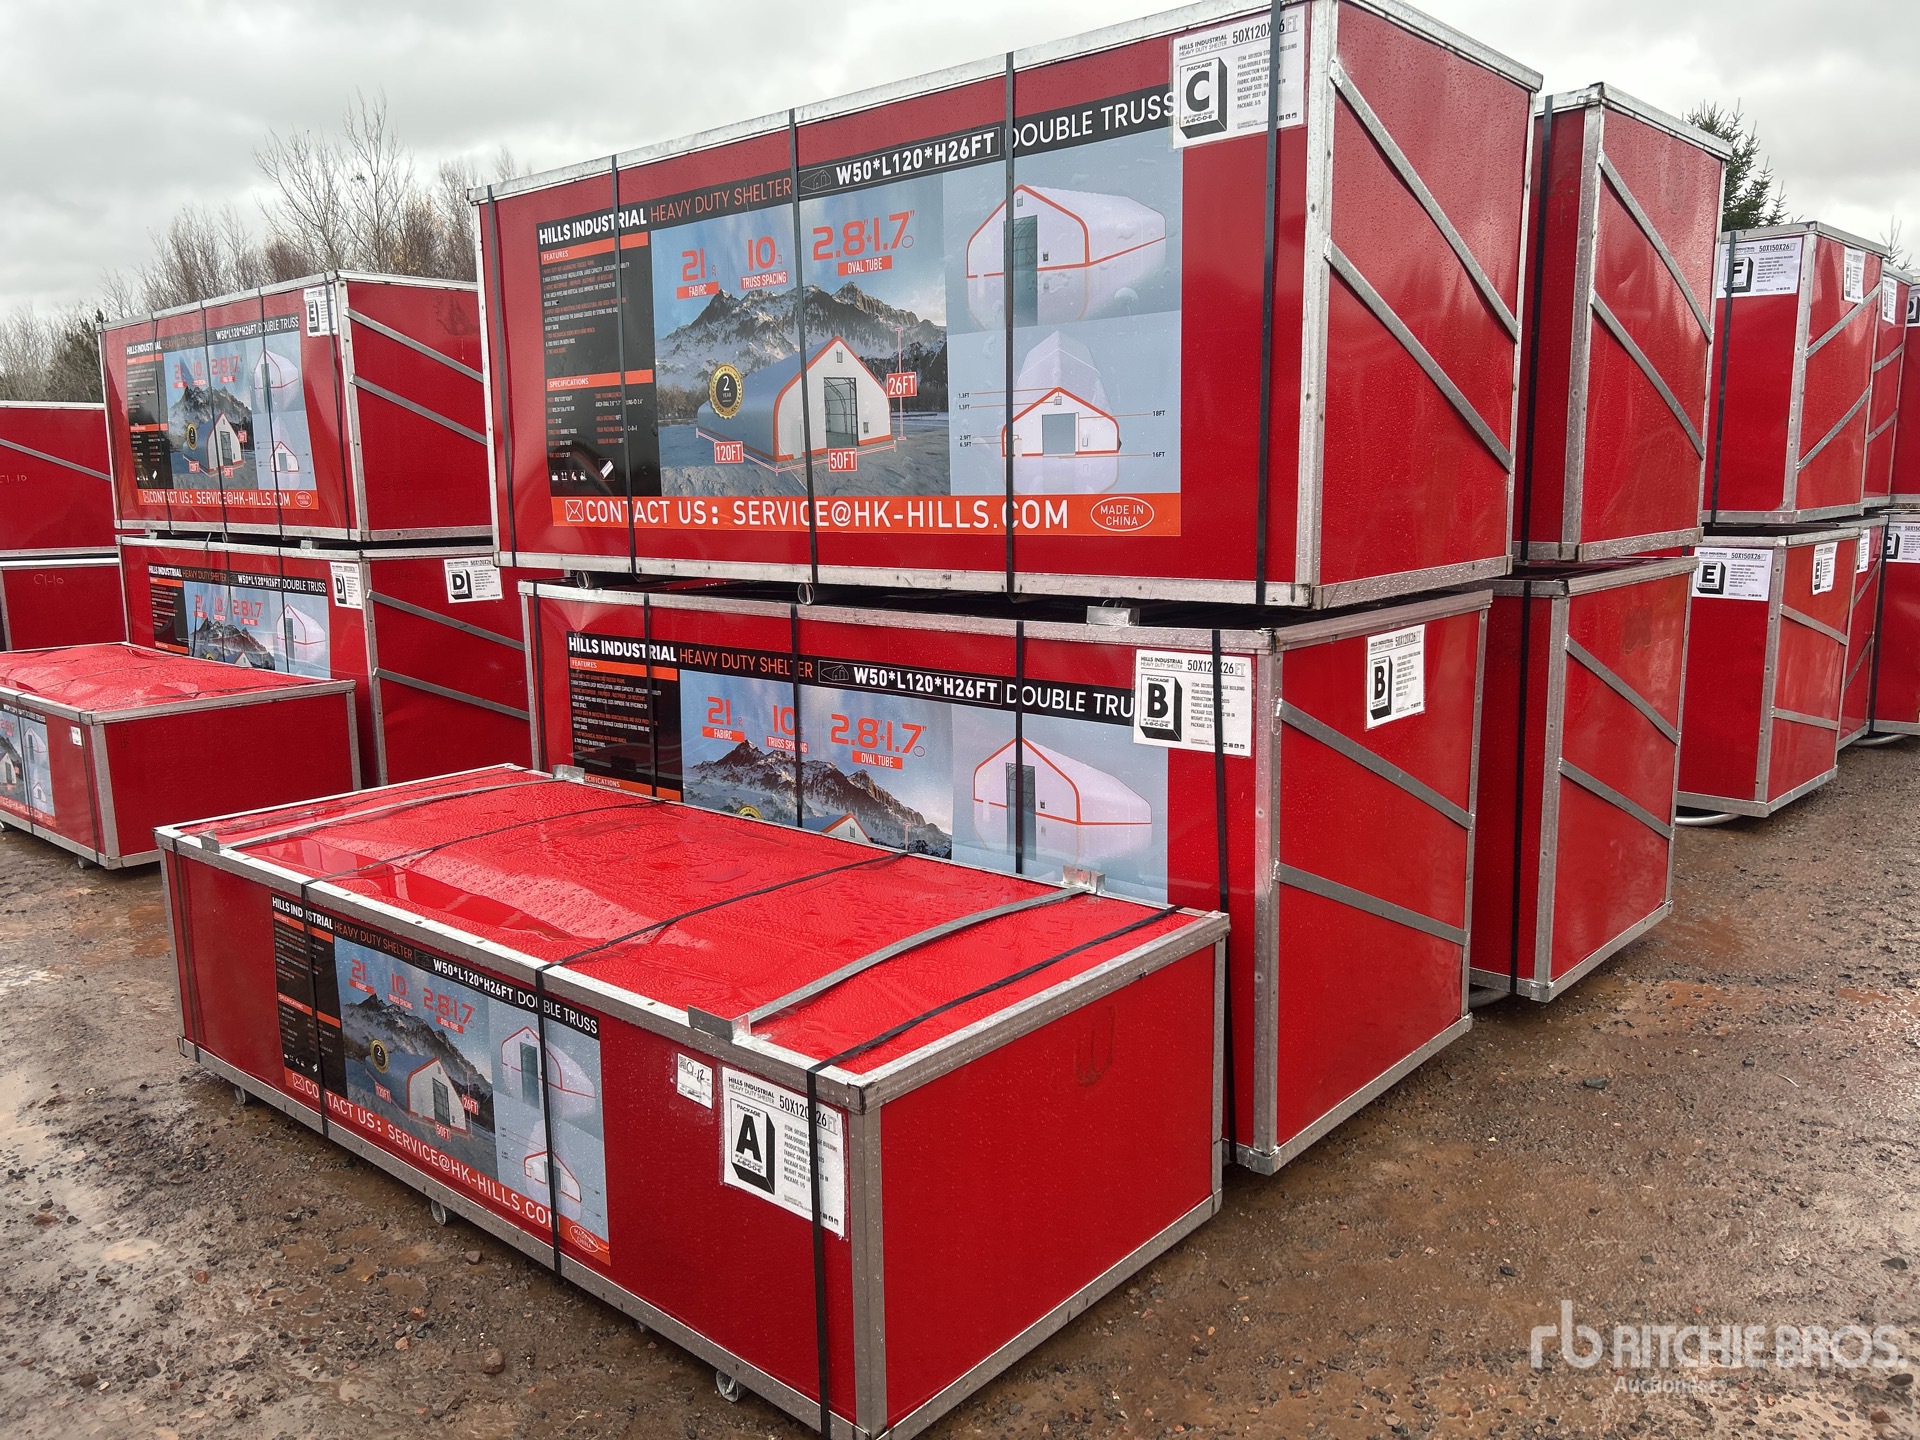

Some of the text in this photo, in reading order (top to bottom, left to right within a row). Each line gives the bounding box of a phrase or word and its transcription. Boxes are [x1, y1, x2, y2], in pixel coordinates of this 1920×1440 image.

[1179, 42, 1194, 52] HILLS
[1194, 34, 1228, 48] INDUSTRIAL
[1179, 48, 1195, 57] HEAVY
[1195, 45, 1208, 53] DUTY
[1186, 61, 1213, 72] PACKAGE
[1185, 70, 1210, 113] C
[539, 224, 571, 246] HILLS
[572, 207, 648, 239] INDUSTRIAL
[650, 198, 693, 223] HEAVY
[695, 190, 730, 213] DUTY
[734, 177, 793, 206] SHELTER
[1004, 110, 1093, 151] DOUBLE
[1100, 91, 1174, 131] TRUSS
[543, 250, 569, 261] FEATURES
[747, 236, 776, 271] 10
[681, 248, 706, 282] 21
[847, 257, 883, 275] OVAL TUBE
[741, 271, 788, 290] TRUSS SPACING
[126, 345, 138, 356] HILLS
[258, 319, 280, 334] DOUBLE
[280, 316, 299, 330] TRUSS
[549, 377, 589, 389] SPECIFICATIONS
[723, 376, 730, 392] 2
[888, 375, 915, 396] 26FT
[1152, 409, 1166, 417] 18FT
[715, 443, 742, 462] 120FT
[830, 450, 856, 470] 50FT
[149, 491, 178, 504] CONTACT
[196, 491, 291, 506] SERVICE@HK-HILLS.COM
[586, 500, 1068, 529] CONTACT US: SERVICE@HK-HILLS.COM
[1100, 504, 1144, 515] MADE IN
[1105, 516, 1139, 527] CHINA
[157, 566, 183, 578] INDUSTRIAL
[282, 578, 307, 590] DOUBLE
[307, 581, 327, 593] TRUSS
[451, 573, 465, 591] D
[1701, 565, 1717, 583] E
[335, 577, 343, 594] D
[571, 659, 598, 669] FEATURES
[1154, 657, 1184, 665] INDUSTRIAL
[1187, 659, 1246, 676] 50X12X26FT
[568, 637, 599, 655] HILLS
[601, 639, 677, 662] INDUSTRIAL
[679, 649, 718, 668] HEAVY
[721, 652, 756, 671] DUTY
[759, 657, 813, 679] SHELER
[1006, 684, 1086, 713] DOUBLE
[1092, 692, 1134, 719] TRU
[1374, 665, 1386, 701] B
[1147, 682, 1169, 719] B
[706, 696, 732, 726] 21
[773, 704, 796, 736] 10
[767, 736, 808, 753] TRUSS SPANG
[860, 752, 894, 768] OVAL TUBE
[585, 774, 621, 788] ECIFICATIONS
[272, 896, 290, 913] HILLS
[334, 920, 359, 938] HEAVY
[360, 929, 382, 947] DUTY
[382, 938, 413, 961] SHELTER
[517, 991, 562, 1019] DOBLE
[563, 1007, 598, 1035] TRUSS
[351, 958, 367, 982] 21
[391, 972, 407, 996] 10
[728, 1077, 743, 1087] HILLS
[743, 1081, 775, 1099] INDUSTRIAL
[728, 1083, 775, 1104] HEAVY DUTY SHELTER
[305, 1080, 354, 1118] COTACT
[736, 1103, 761, 1118] PACKAGE
[436, 1124, 450, 1140] 50FT
[735, 1113, 763, 1163] A
